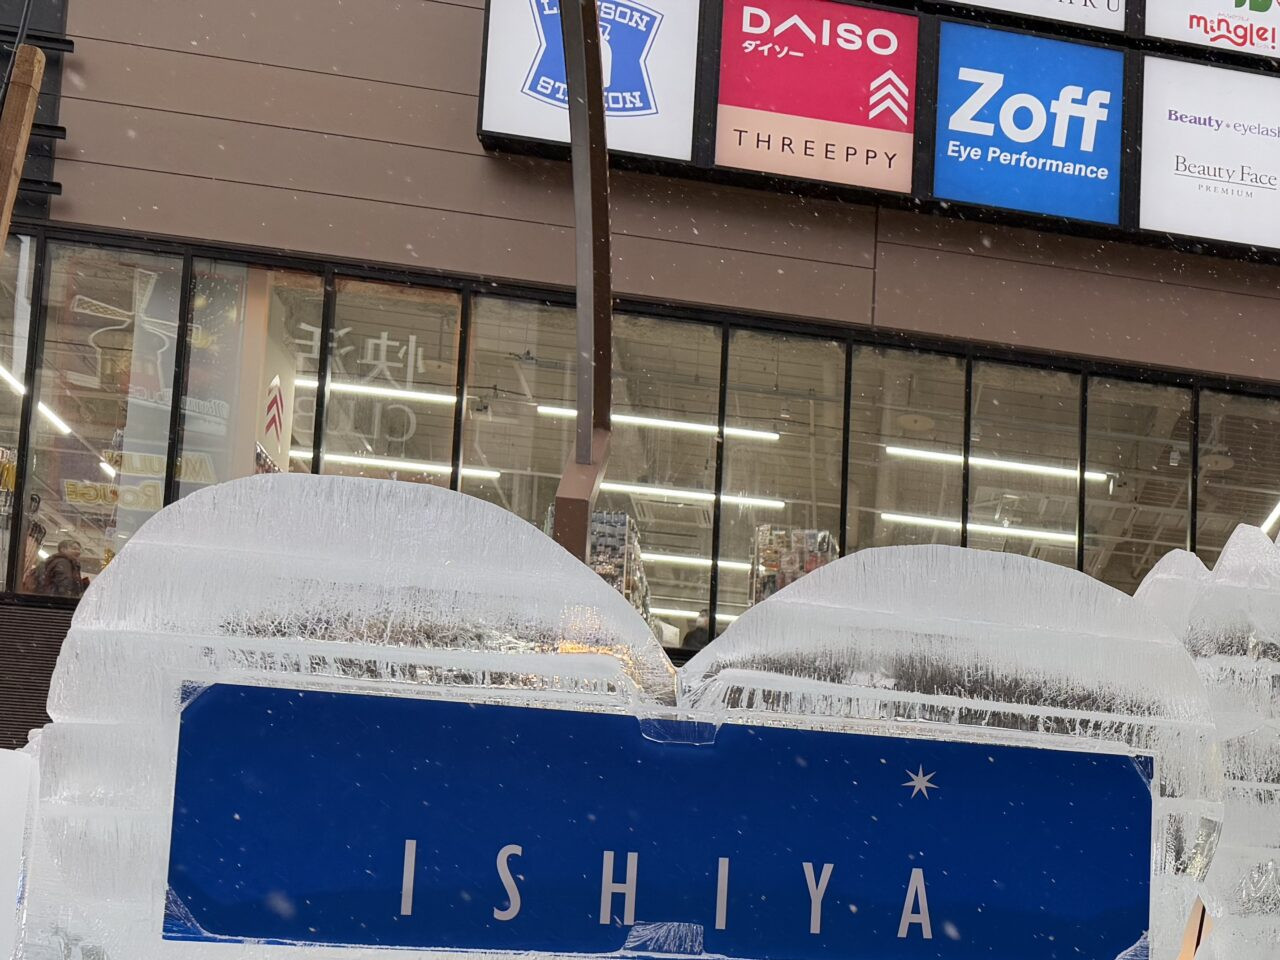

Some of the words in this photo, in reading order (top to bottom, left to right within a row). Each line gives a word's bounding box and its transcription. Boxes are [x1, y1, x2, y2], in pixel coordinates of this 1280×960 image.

[742, 6, 898, 56] DAISO
[742, 40, 804, 58] ダイソー
[1189, 14, 1276, 50] mingle!
[948, 67, 1111, 152] Zoff
[1168, 109, 1224, 131] Beauty
[733, 128, 897, 169] THREEPPY
[947, 140, 982, 162] Eye
[987, 146, 1109, 180] Performance
[1175, 155, 1235, 182] Beauty
[1240, 165, 1277, 186] Face
[1198, 184, 1253, 198] PREMIUM
[400, 839, 934, 940] ISHIYA
